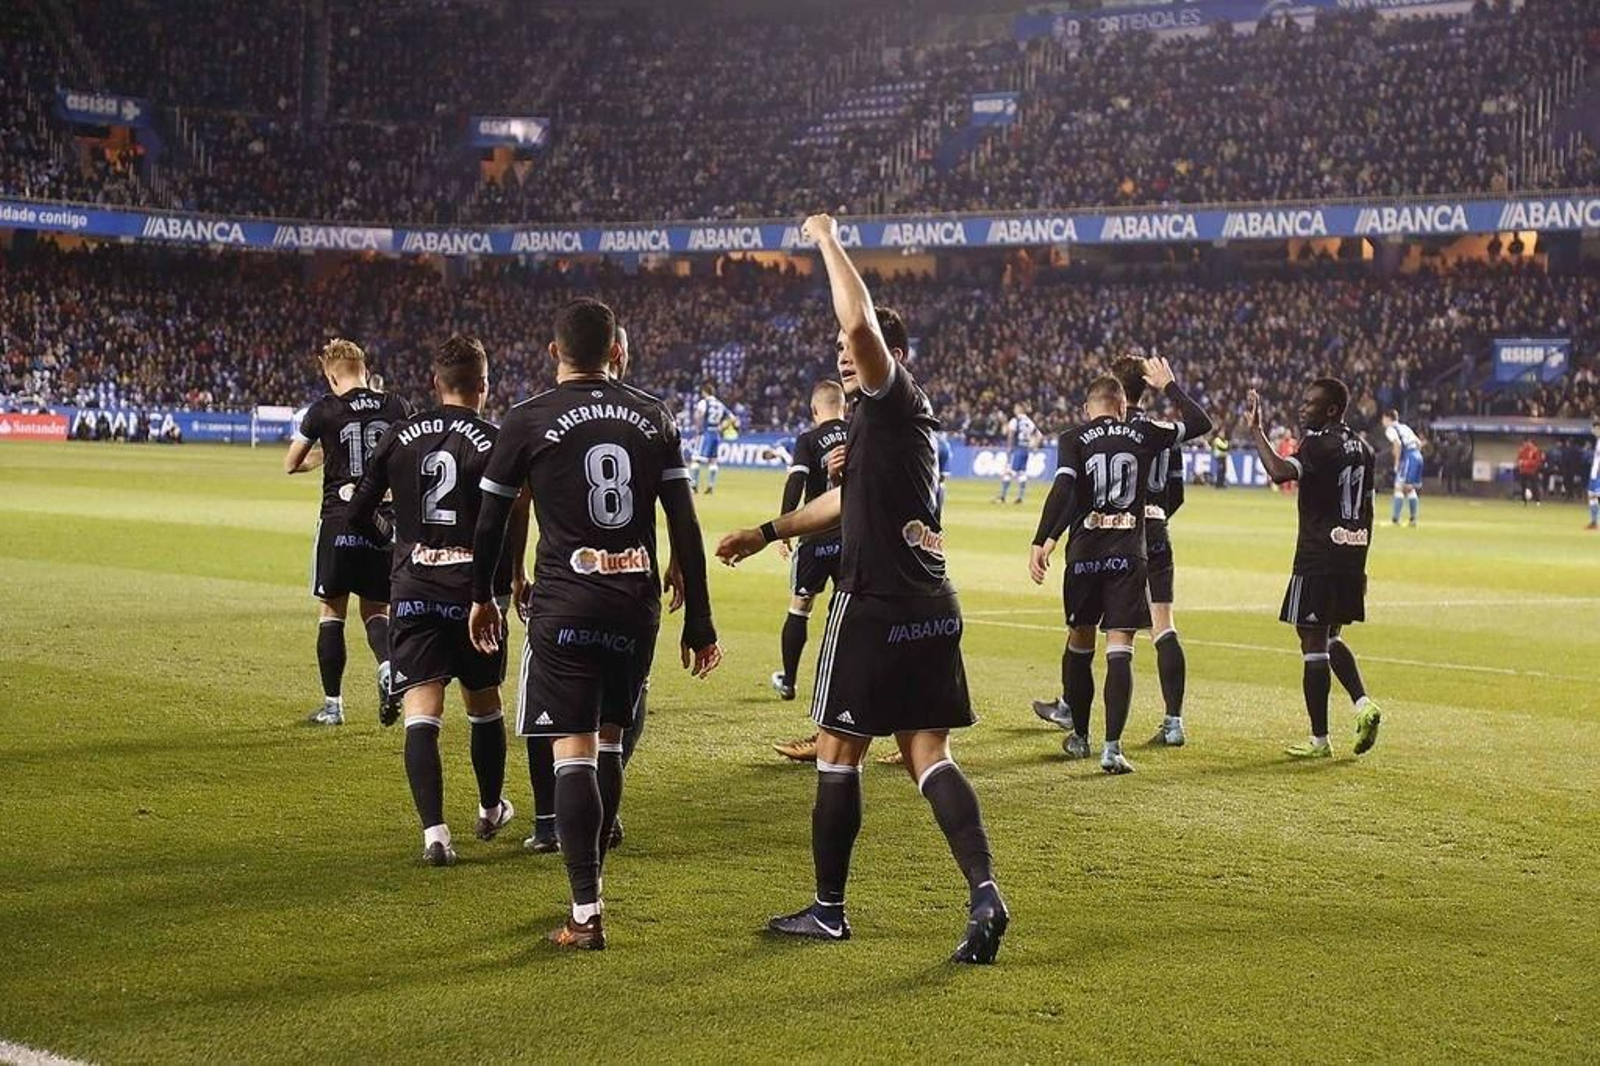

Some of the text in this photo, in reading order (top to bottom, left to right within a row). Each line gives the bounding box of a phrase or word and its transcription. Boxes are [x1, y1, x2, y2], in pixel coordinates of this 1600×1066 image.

[39, 210, 88, 229] contigo
[788, 225, 862, 248] ACA
[350, 400, 381, 412] WASS
[13, 421, 67, 435] Santander
[398, 419, 493, 453] HUGO MALLO
[545, 404, 658, 443] P.HERNANDEZ
[1107, 425, 1145, 444] ASPAS
[421, 450, 457, 525] 2
[585, 443, 634, 529] 8
[1085, 452, 1139, 509] 10
[1338, 465, 1365, 520] 11
